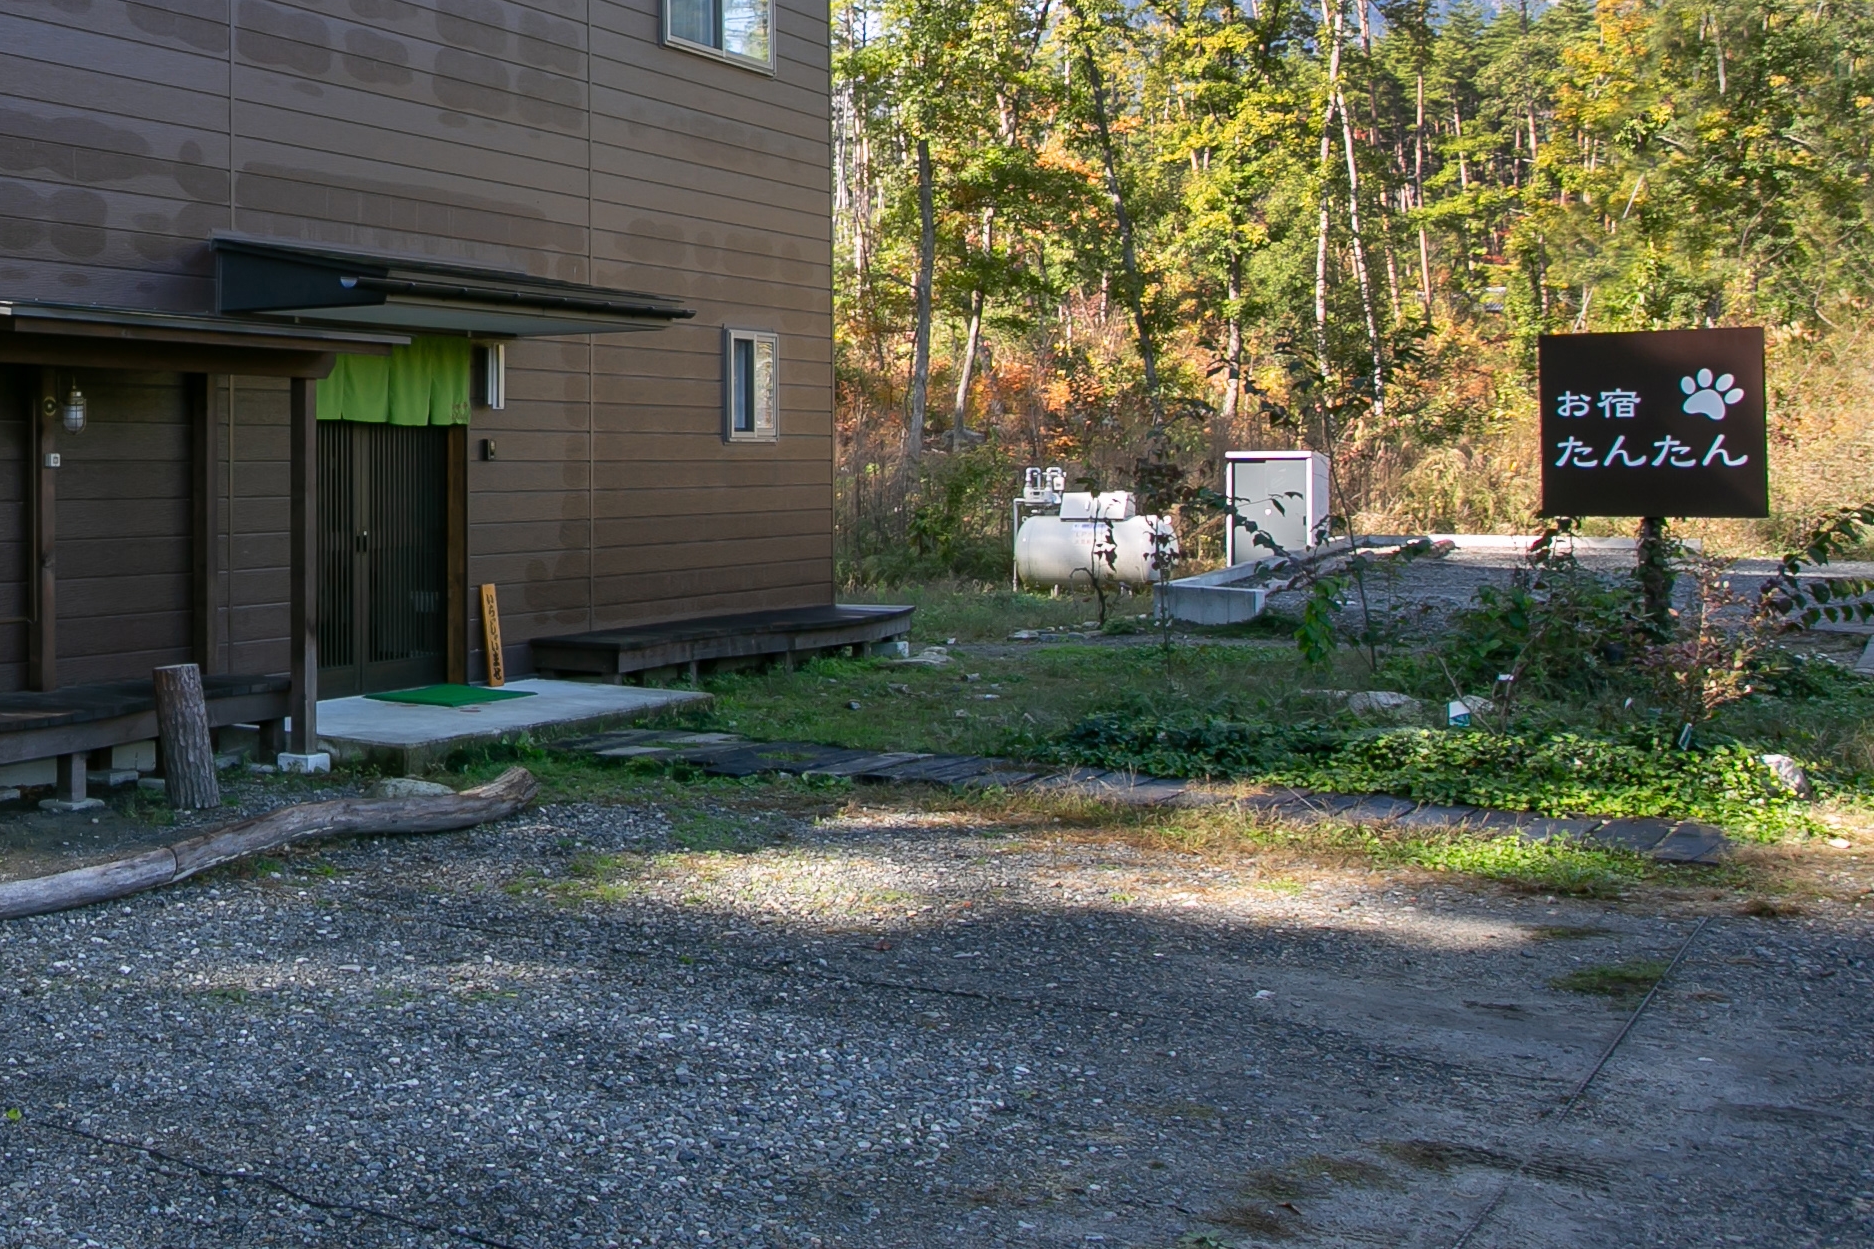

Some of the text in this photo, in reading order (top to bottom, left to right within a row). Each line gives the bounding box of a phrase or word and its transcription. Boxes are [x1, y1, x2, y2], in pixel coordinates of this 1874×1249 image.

[1556, 388, 1641, 418] お宿
[1555, 434, 1748, 467] たんたん
